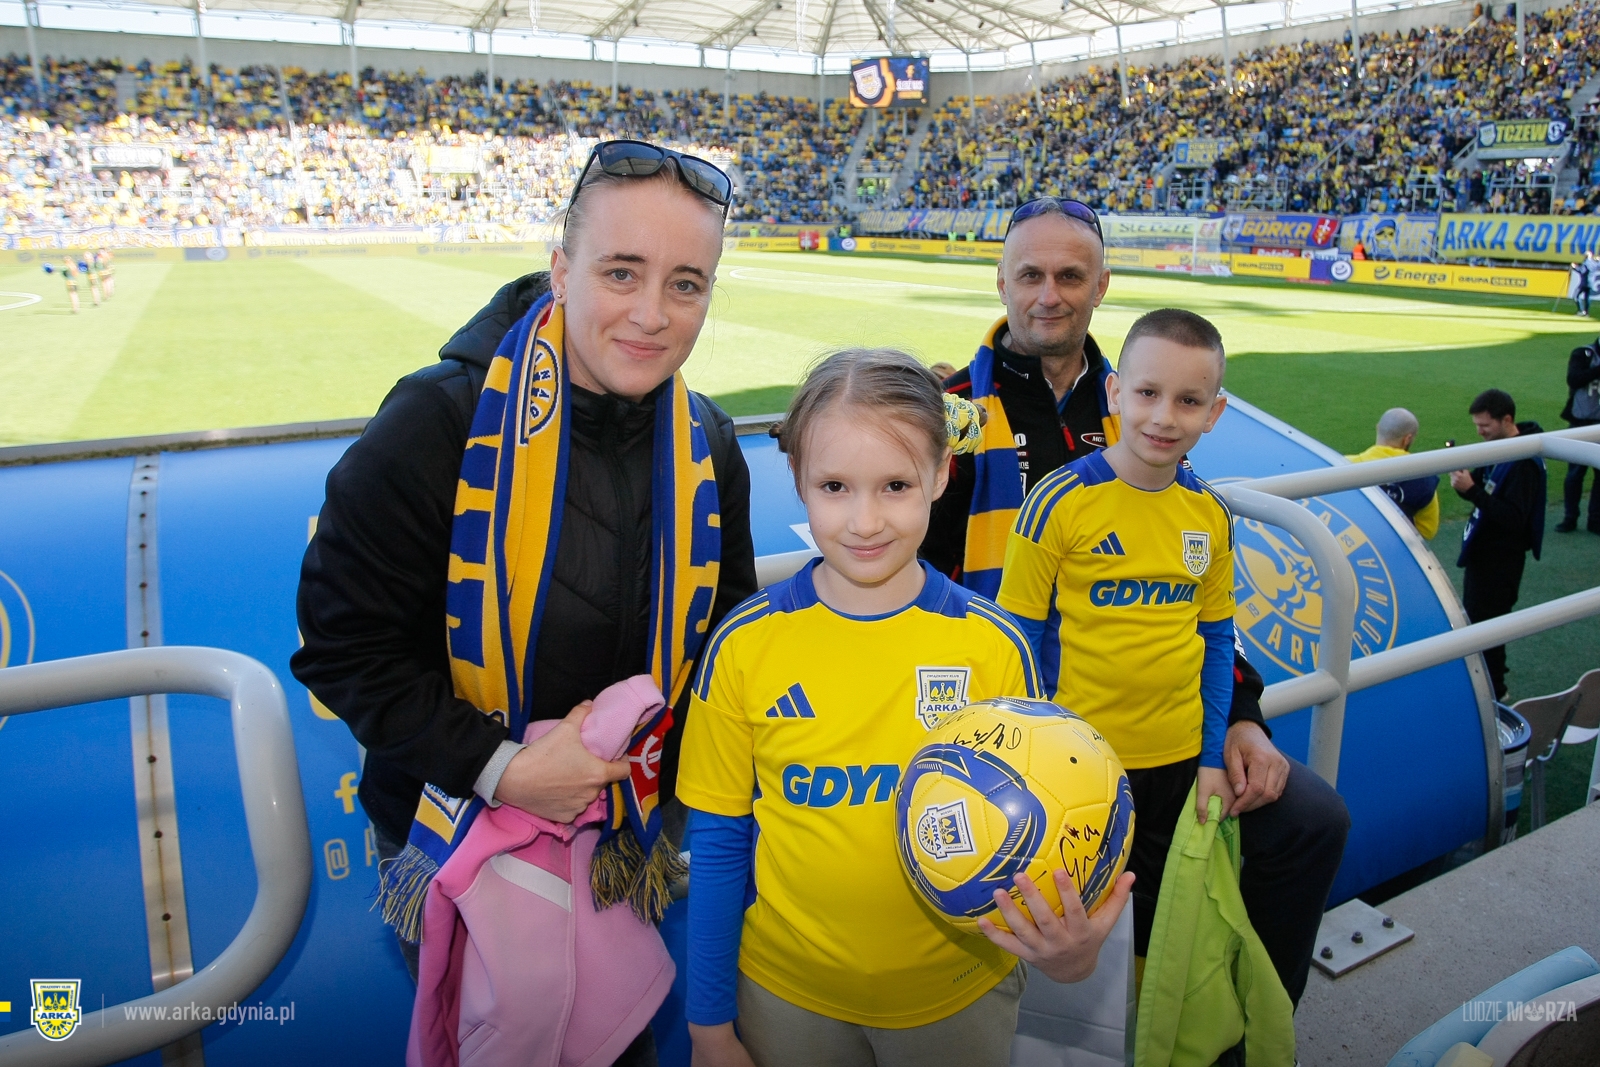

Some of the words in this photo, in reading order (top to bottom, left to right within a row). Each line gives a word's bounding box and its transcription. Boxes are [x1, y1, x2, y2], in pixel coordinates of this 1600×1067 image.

[1496, 123, 1548, 143] TCZEW
[1442, 219, 1508, 251] ARKA
[1394, 268, 1447, 284] Energa
[1089, 579, 1198, 607] GDYNIA
[782, 763, 901, 809] GDYN
[930, 816, 942, 851] ARKA
